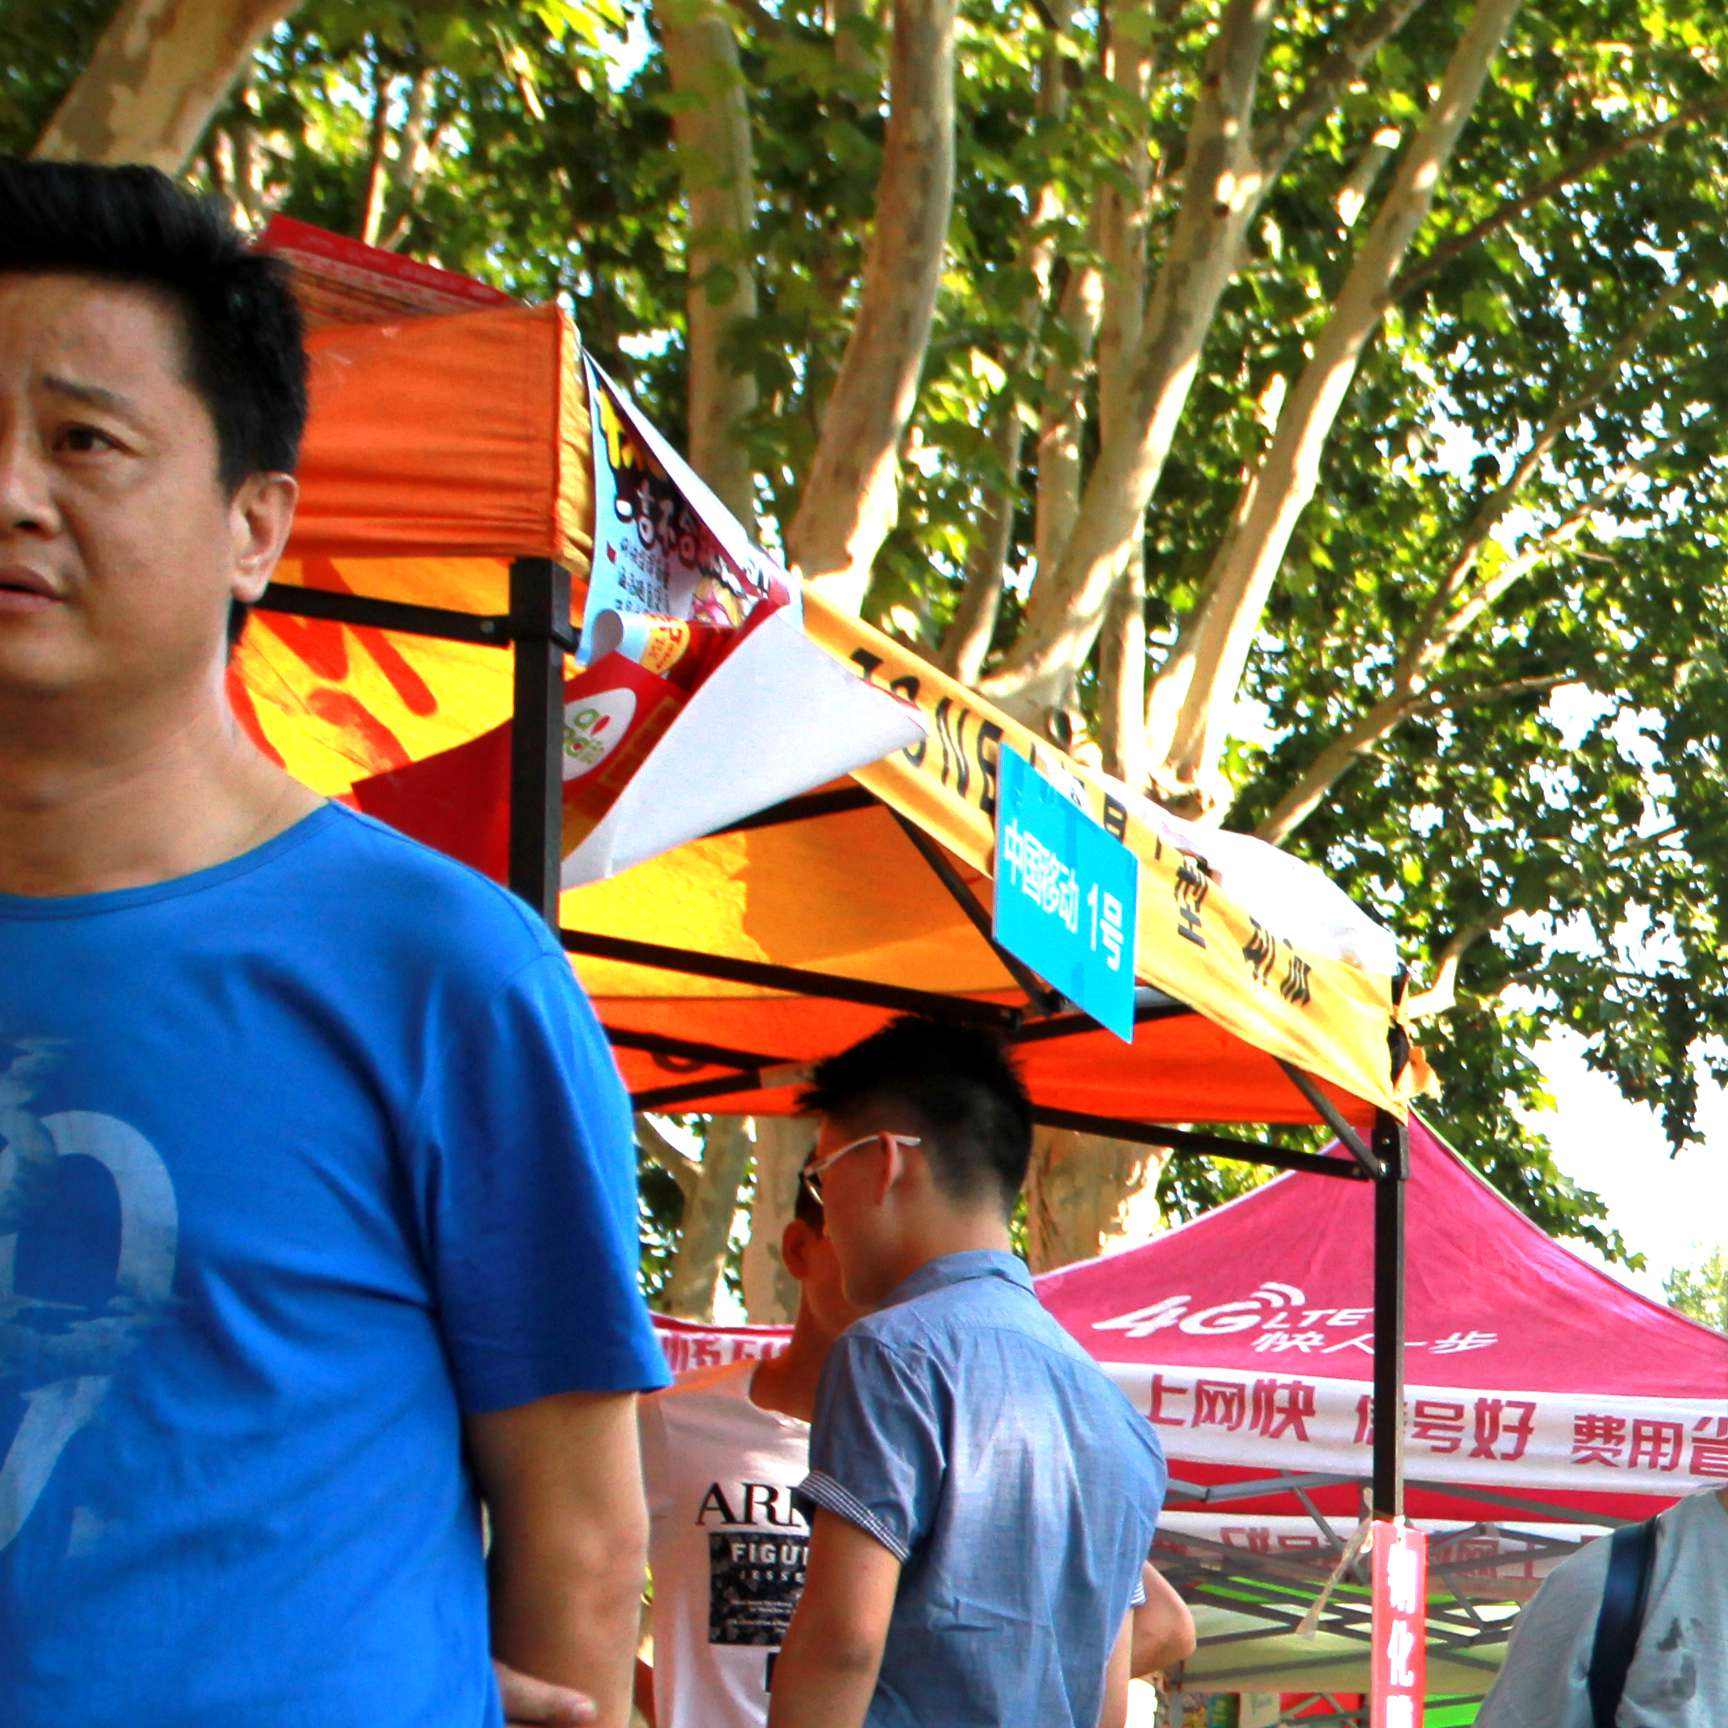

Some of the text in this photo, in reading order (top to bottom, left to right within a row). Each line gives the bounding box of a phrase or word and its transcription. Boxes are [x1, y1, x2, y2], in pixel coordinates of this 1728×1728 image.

[1004, 816, 1079, 934] 中国移动
[1087, 882, 1124, 972] 1号
[1091, 1295, 1374, 1337] 4G LTE
[1251, 1330, 1498, 1354] 快人一步
[1147, 1374, 1316, 1442] 上网快
